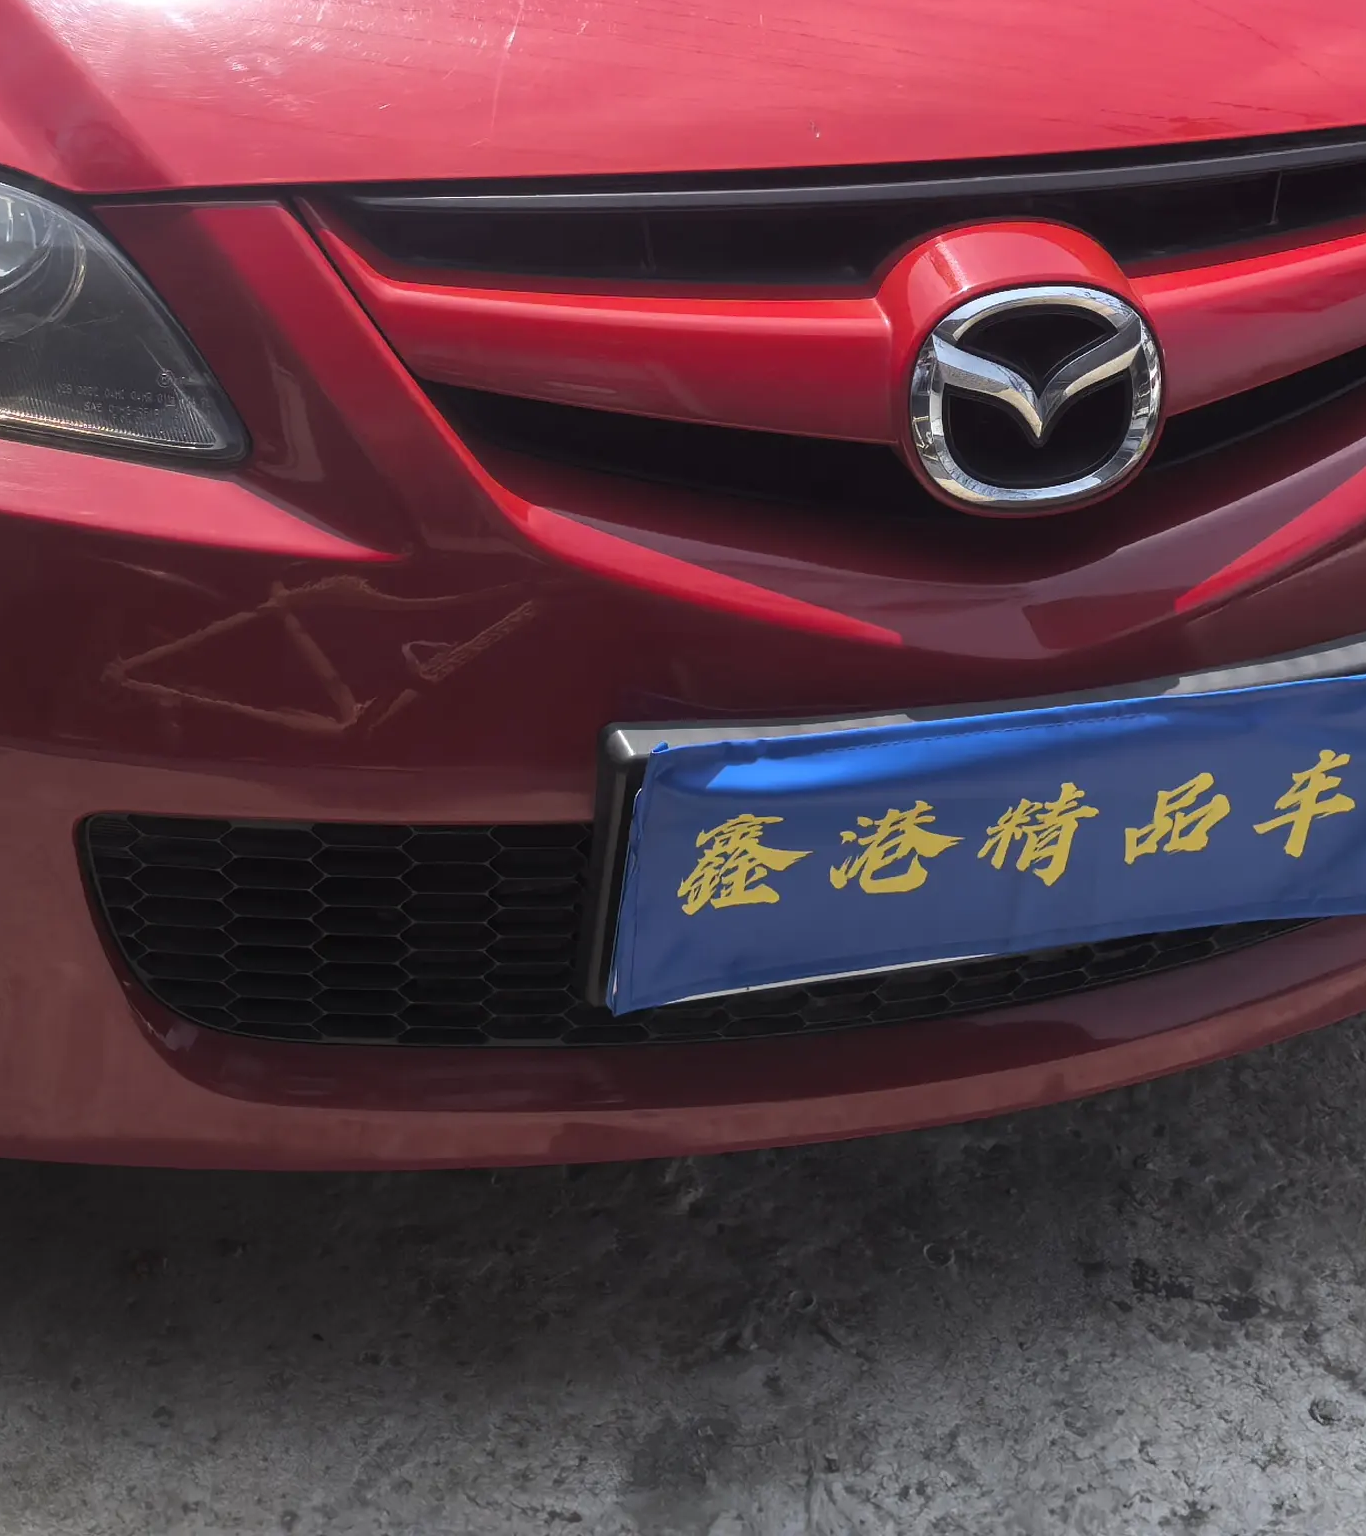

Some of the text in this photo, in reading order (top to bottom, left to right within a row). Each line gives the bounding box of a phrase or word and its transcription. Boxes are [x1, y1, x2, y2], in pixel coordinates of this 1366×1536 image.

[677, 749, 1357, 917] 鑫港精品车
